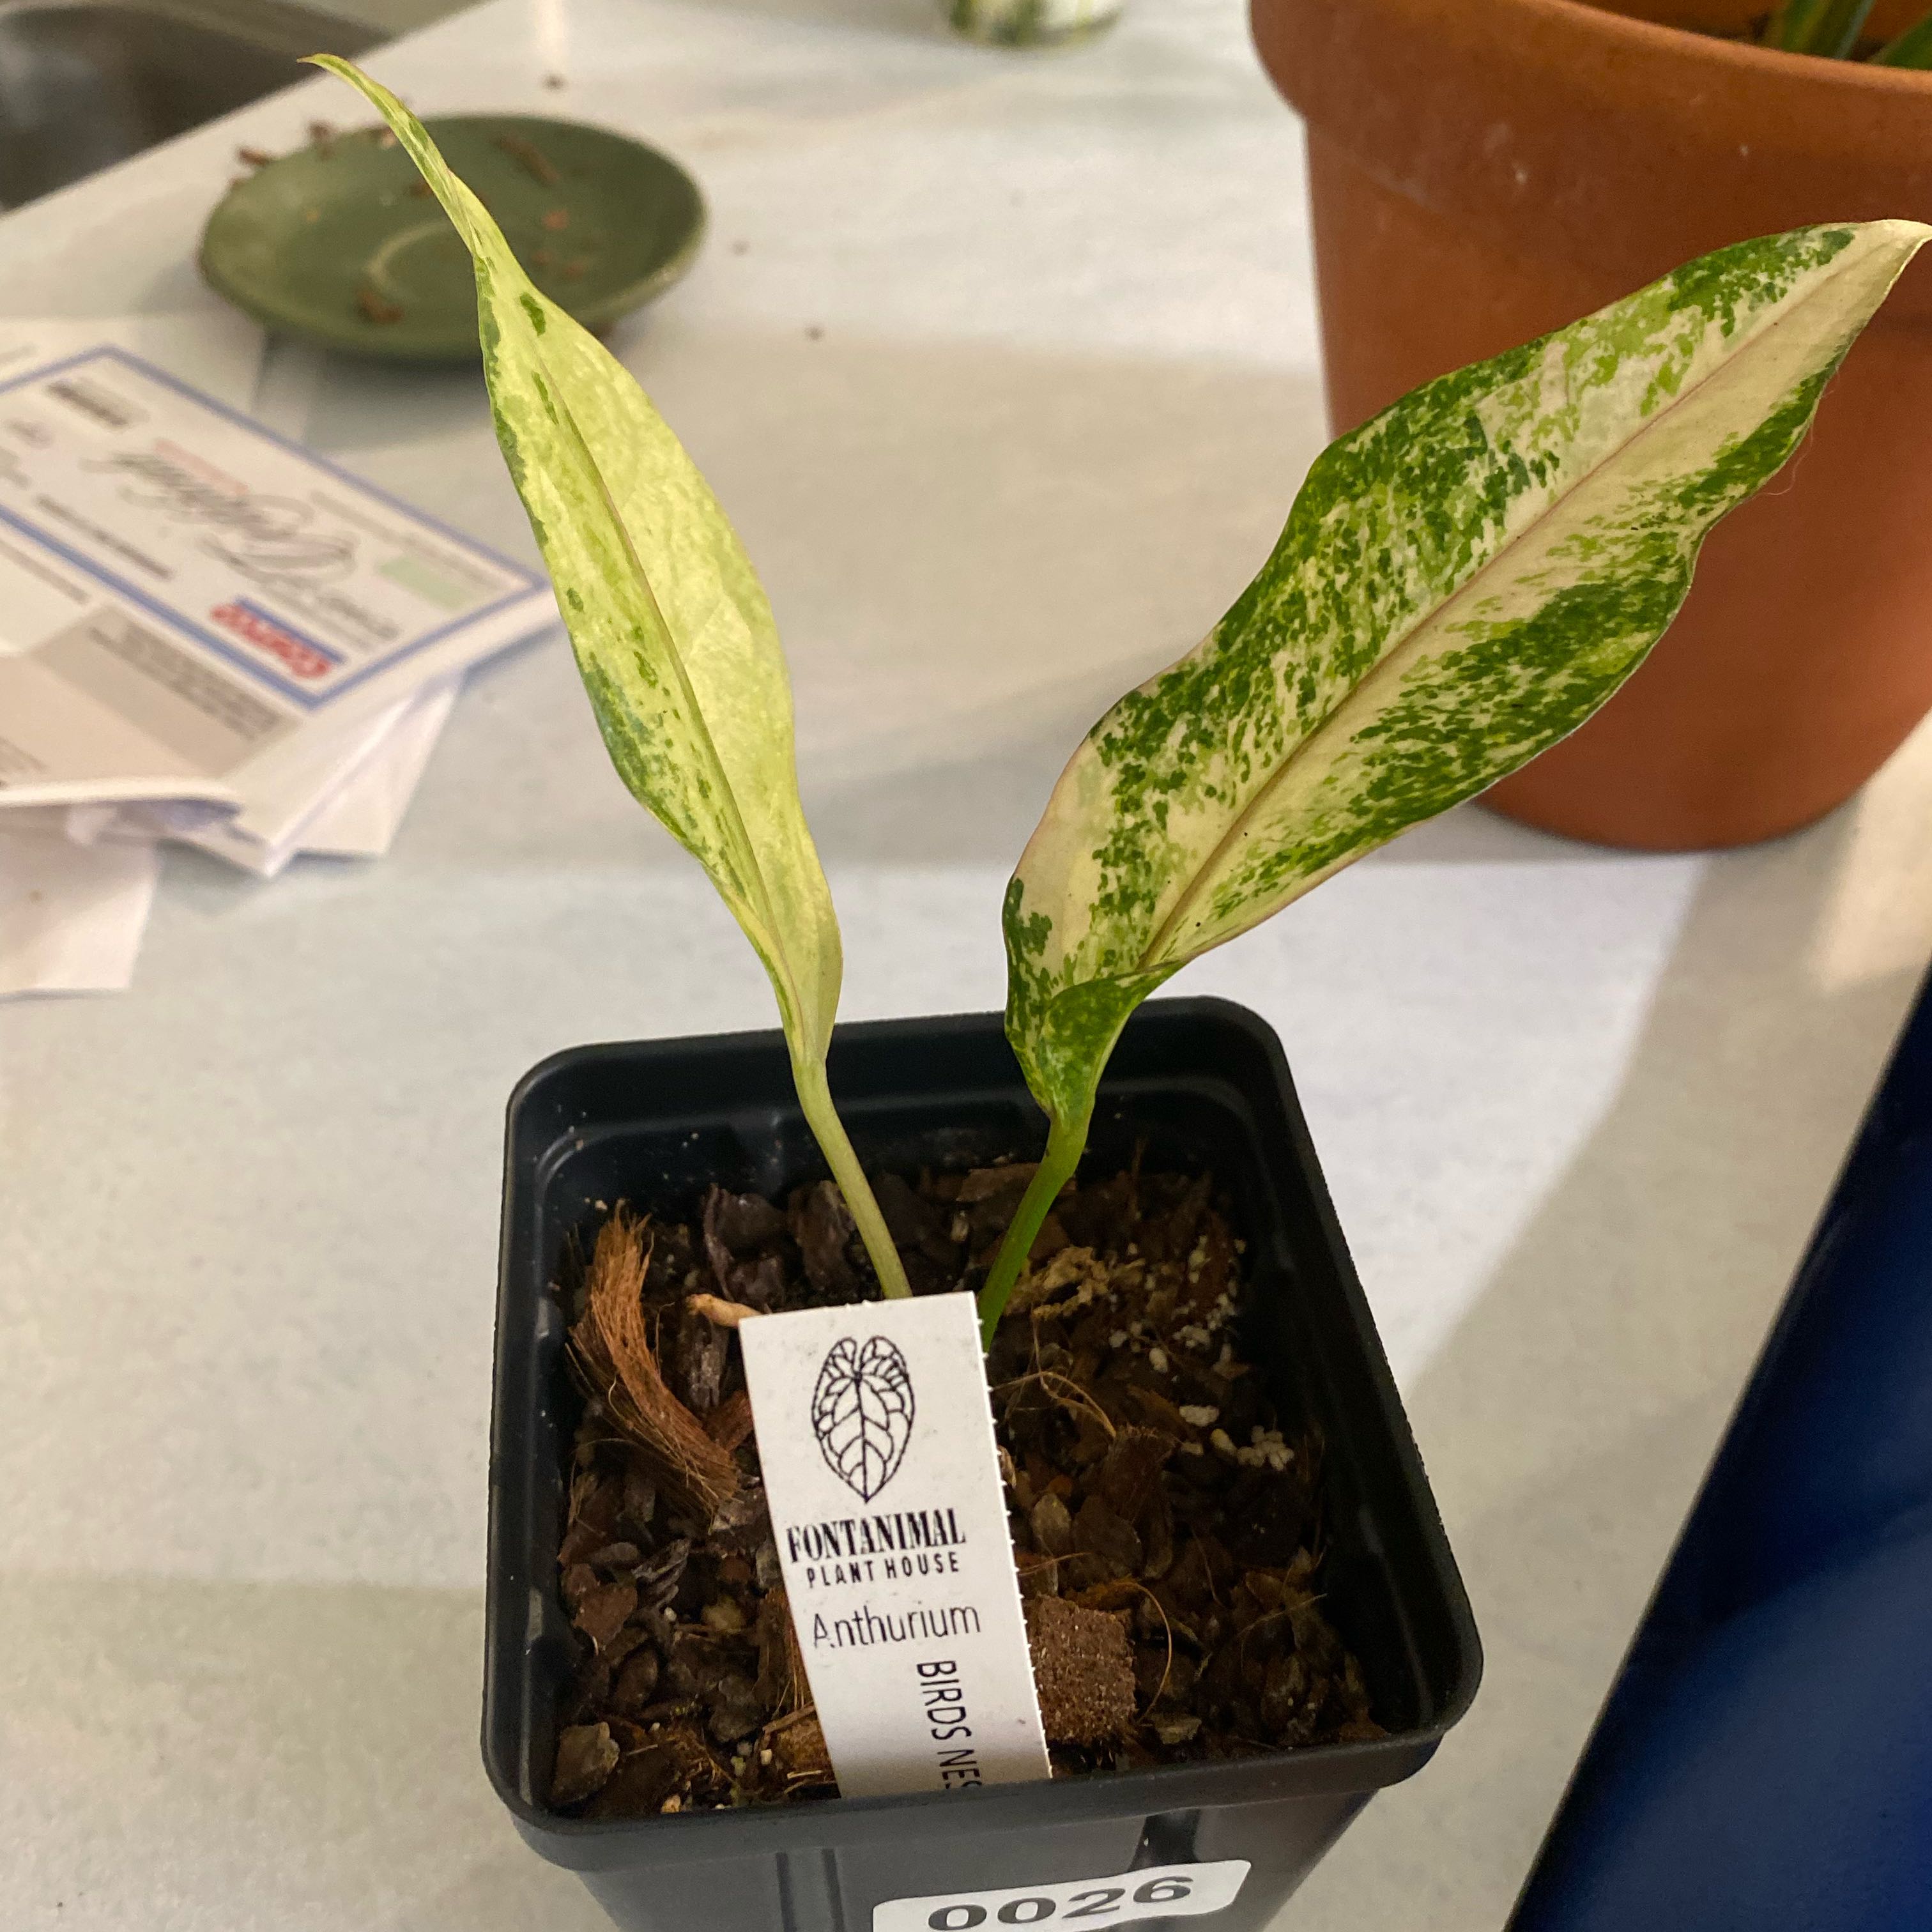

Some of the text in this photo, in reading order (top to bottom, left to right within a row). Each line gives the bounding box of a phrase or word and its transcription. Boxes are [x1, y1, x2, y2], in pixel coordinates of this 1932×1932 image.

[786, 1508, 966, 1563] FONTANIMAL
[806, 1551, 959, 1588] PLANT HOUSE
[813, 1605, 981, 1648] Anthurium
[916, 1660, 972, 1740] BIRDS
[928, 1876, 1194, 1931] 0026
